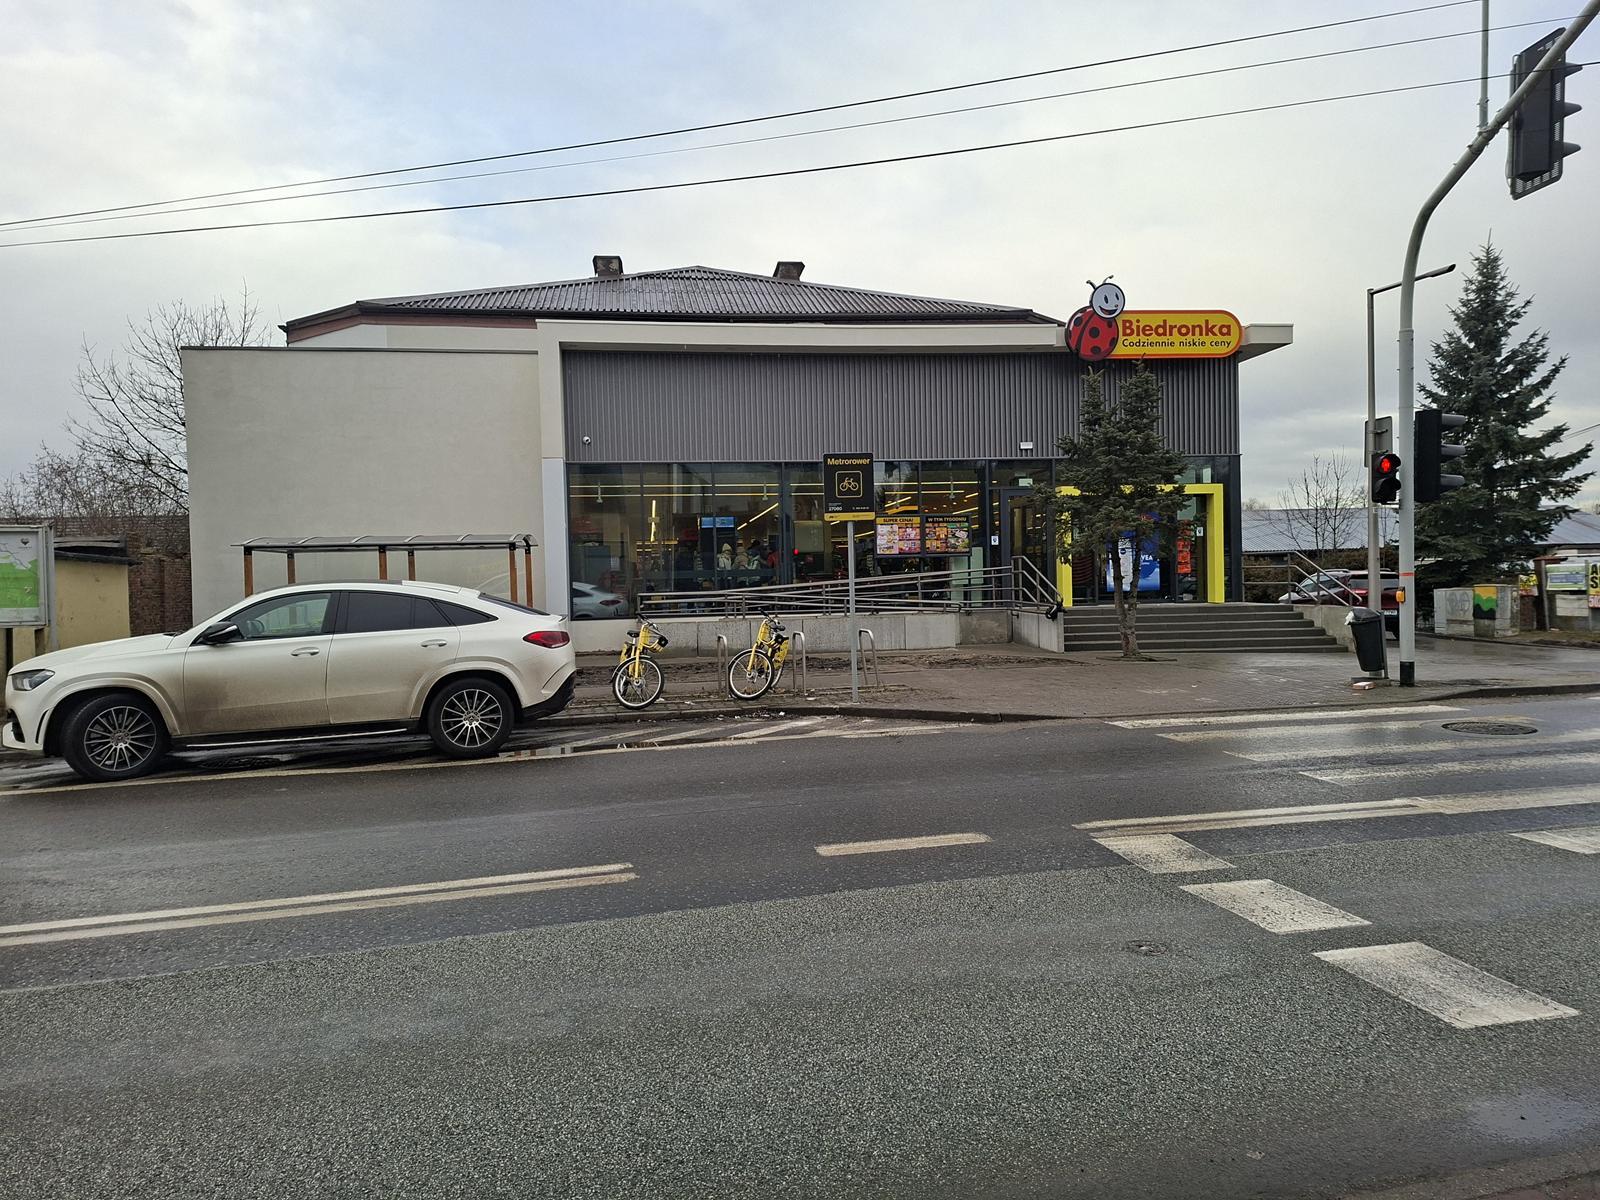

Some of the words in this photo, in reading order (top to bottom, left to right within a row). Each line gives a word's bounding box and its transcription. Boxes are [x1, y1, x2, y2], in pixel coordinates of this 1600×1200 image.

[1121, 319, 1232, 337] Biedronka
[1122, 338, 1175, 348] Codziennie
[1179, 338, 1207, 347] niskie
[1209, 340, 1232, 349] ceny
